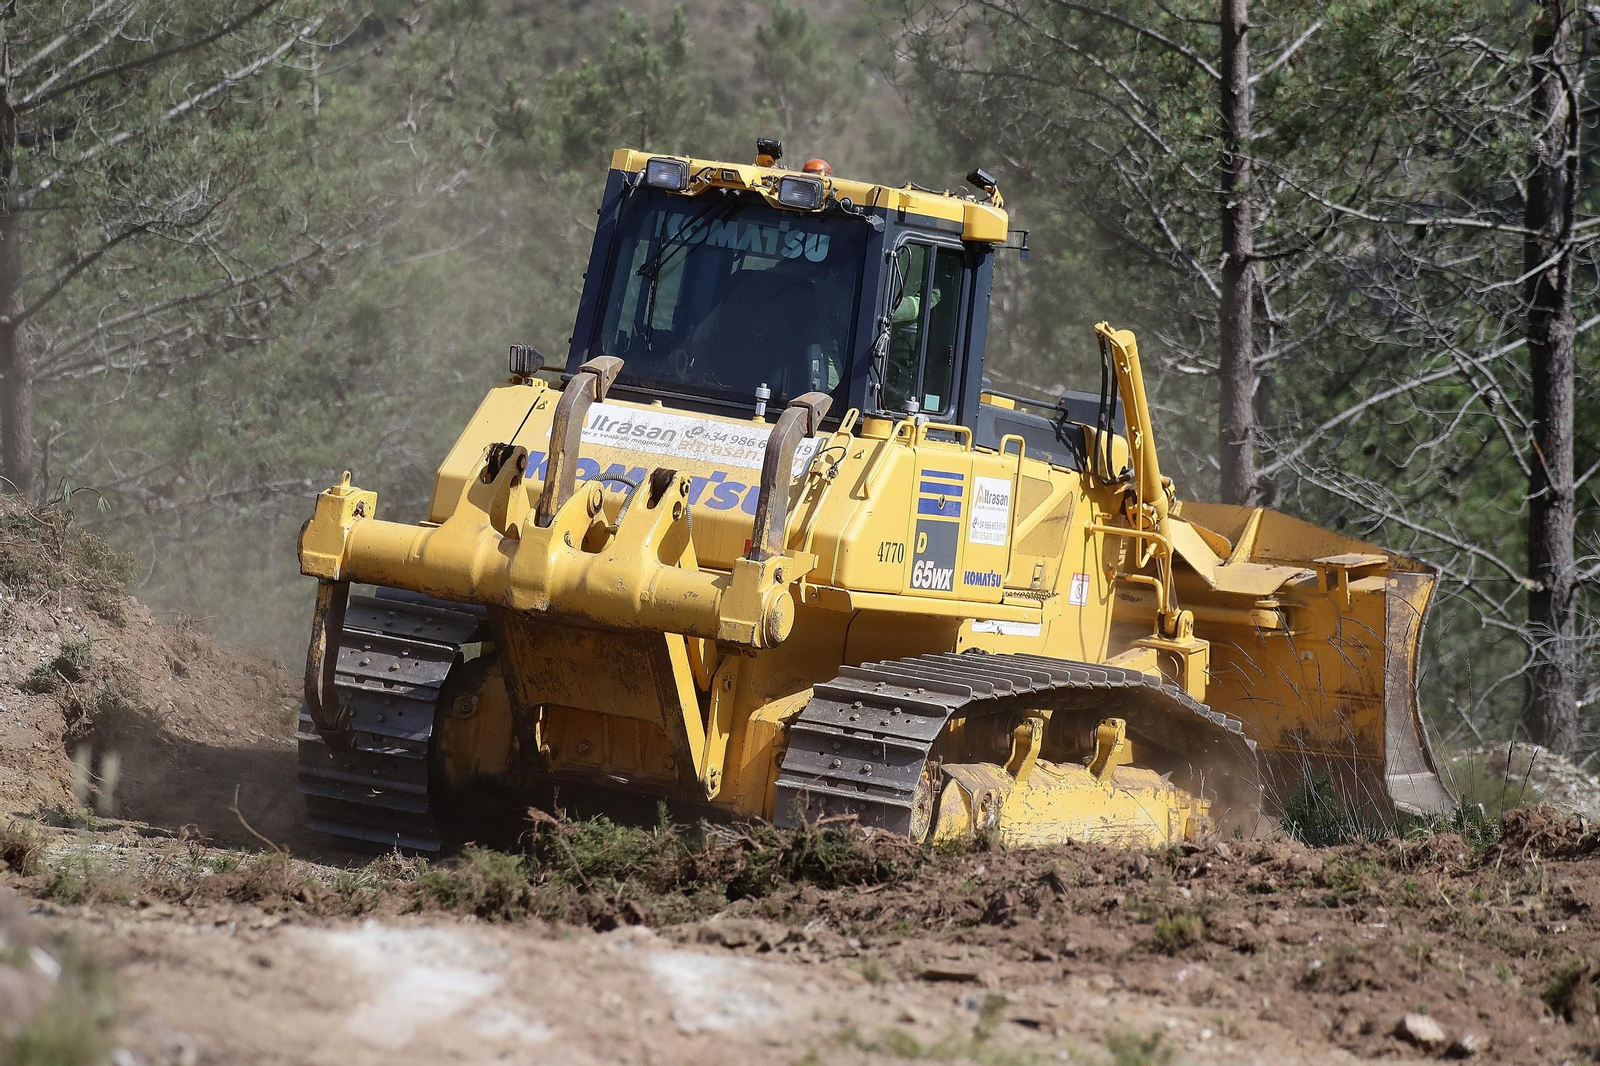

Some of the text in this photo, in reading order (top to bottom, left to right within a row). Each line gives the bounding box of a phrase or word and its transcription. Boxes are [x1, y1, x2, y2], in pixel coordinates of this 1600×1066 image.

[655, 210, 831, 263] KOMATSU
[582, 411, 677, 442] ltrasan
[702, 431, 727, 443] +34
[730, 435, 757, 447] 986
[796, 445, 812, 456] 19
[974, 484, 1009, 508] Altrasan
[877, 541, 905, 564] 4770
[916, 531, 928, 554] D
[963, 569, 1002, 588] KOMATSU
